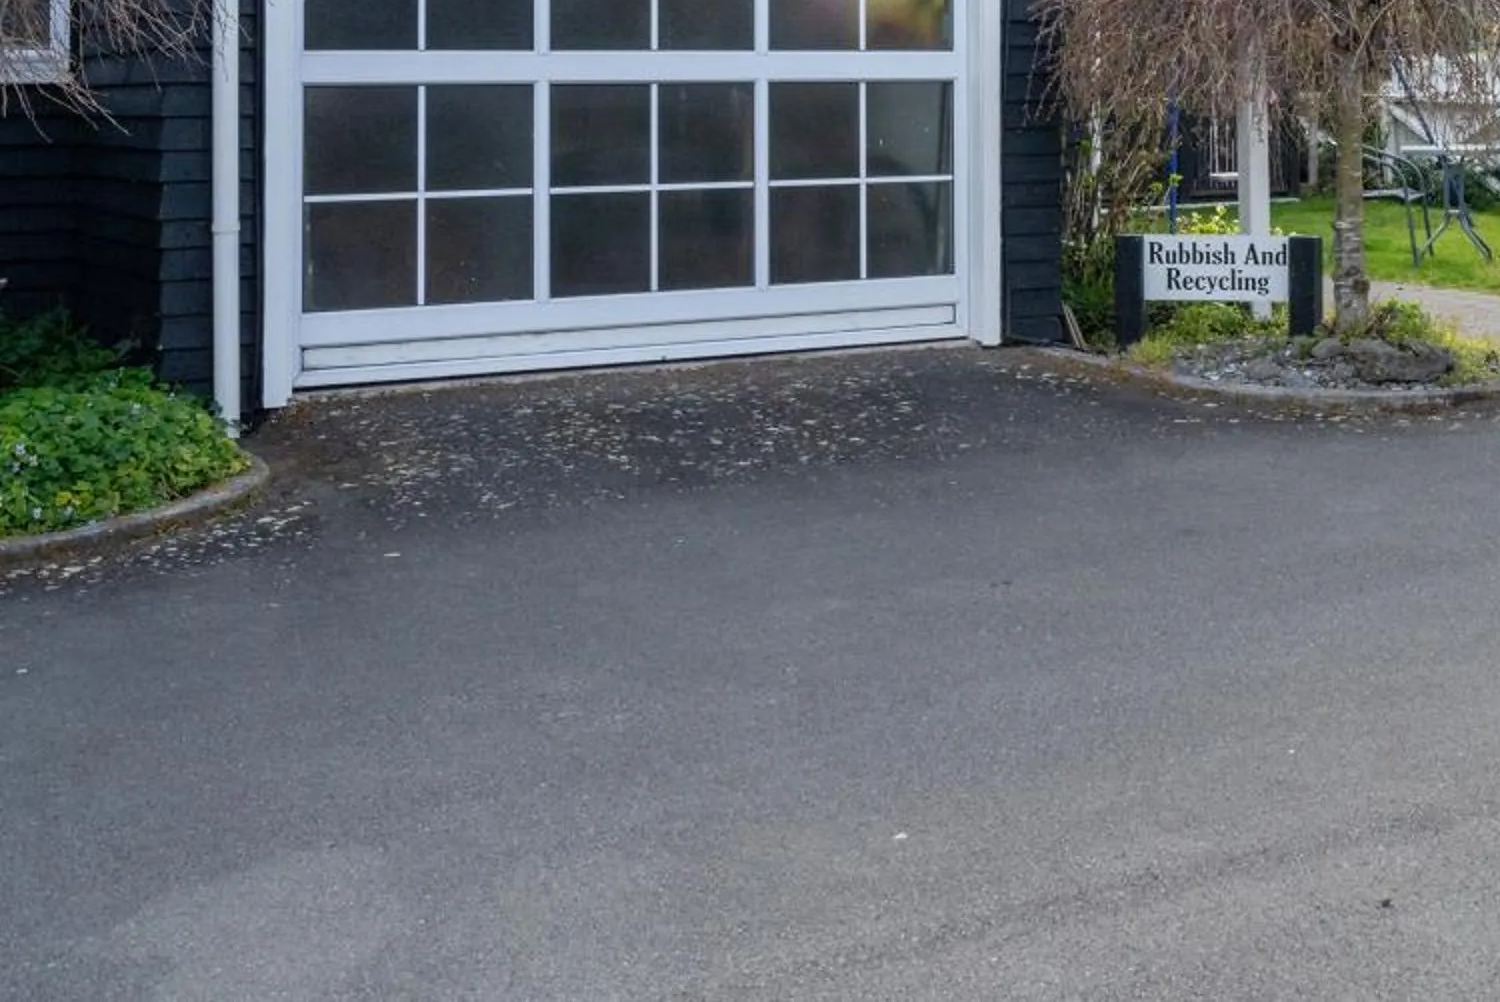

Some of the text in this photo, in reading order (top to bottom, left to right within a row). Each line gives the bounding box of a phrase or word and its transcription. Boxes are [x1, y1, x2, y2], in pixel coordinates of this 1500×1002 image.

[1148, 241, 1288, 266] Rubbish And
[1166, 267, 1270, 295] Recycling
